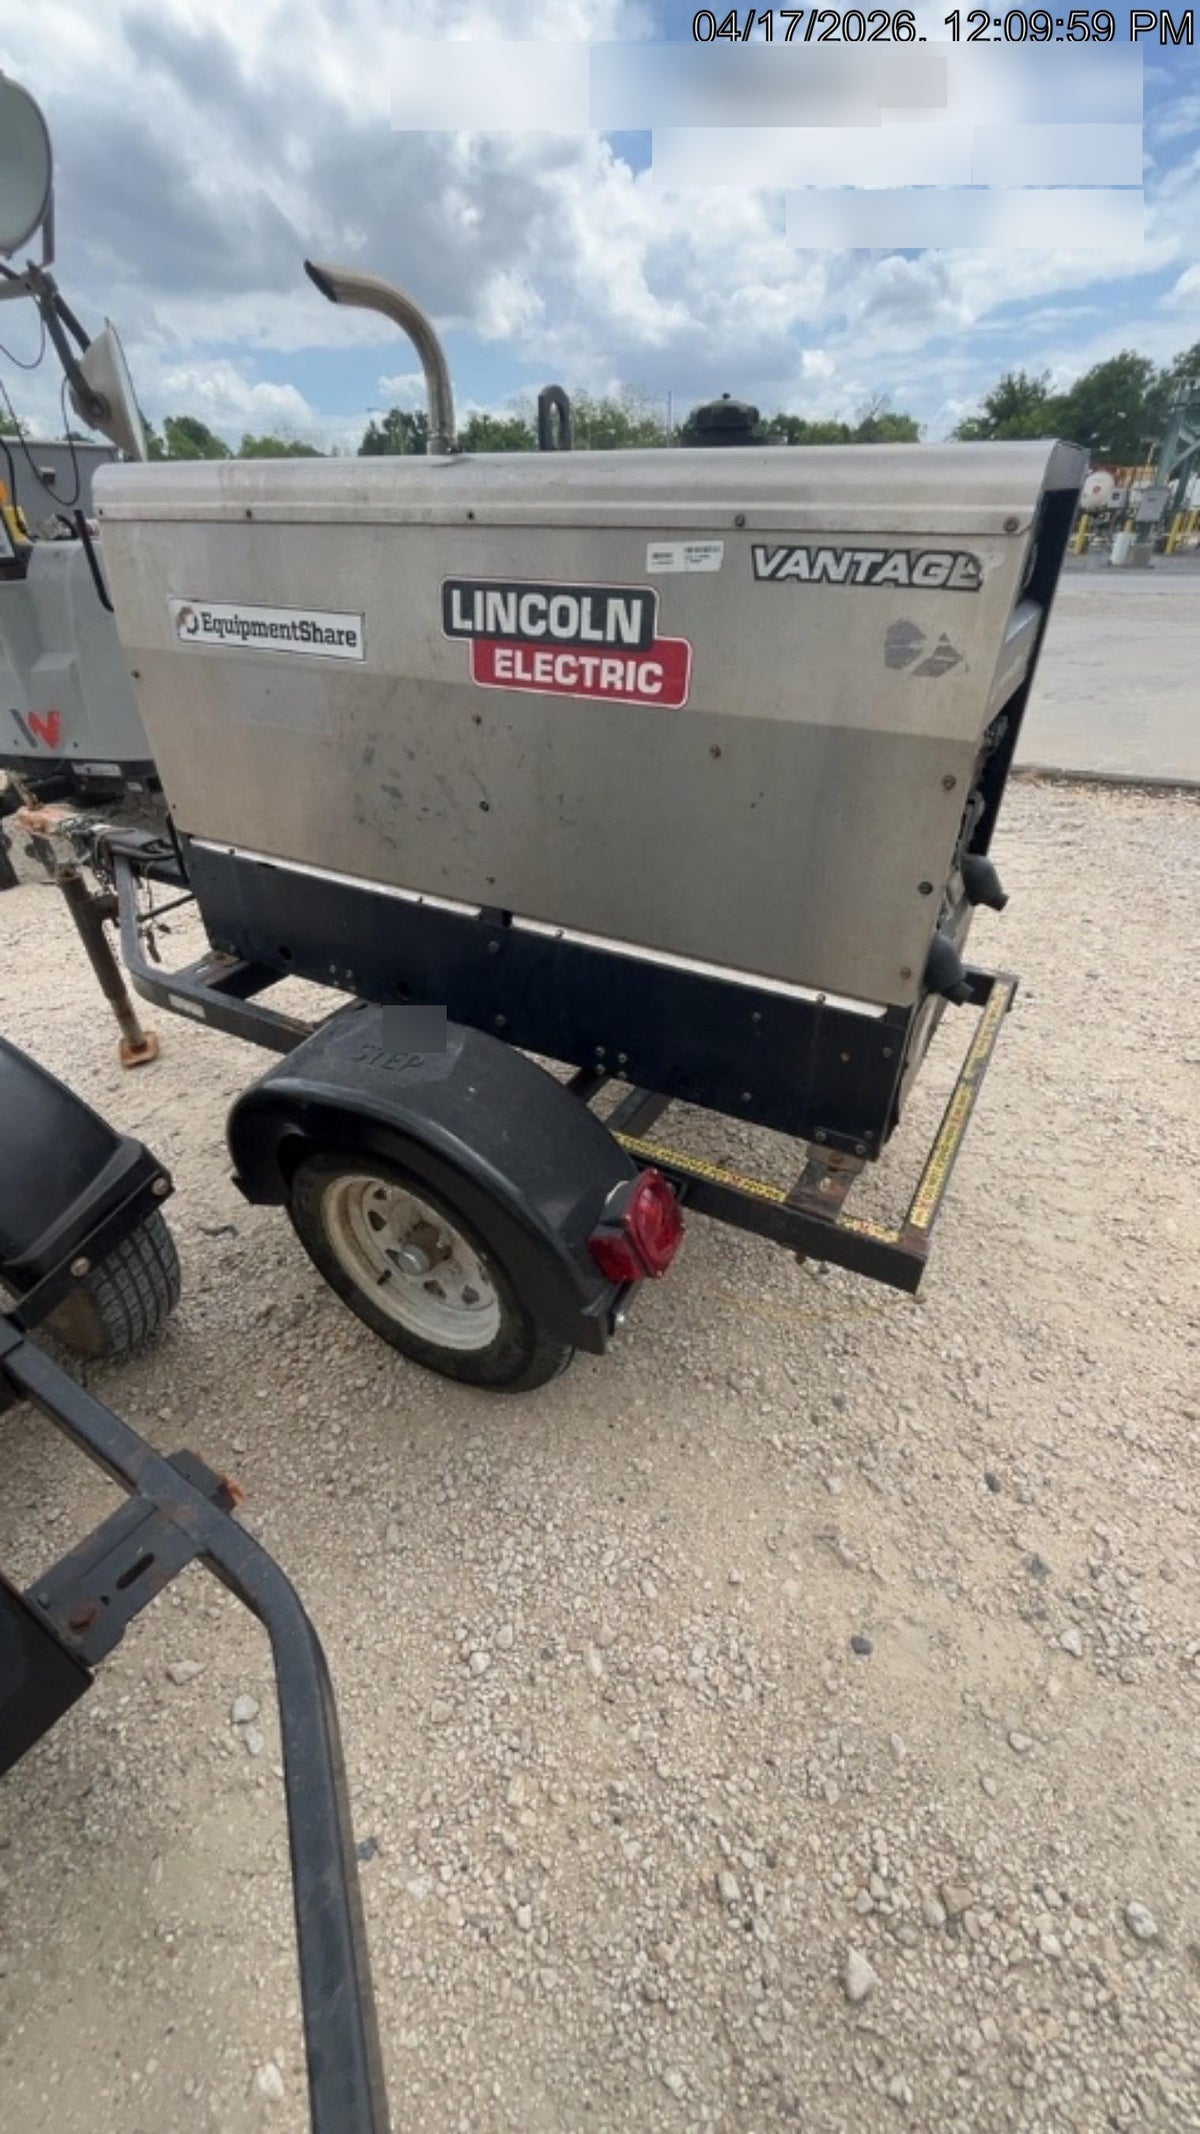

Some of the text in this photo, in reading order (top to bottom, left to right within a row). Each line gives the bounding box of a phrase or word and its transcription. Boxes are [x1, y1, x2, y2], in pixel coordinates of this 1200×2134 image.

[201, 612, 357, 647] EquipmentShare
[452, 589, 642, 643] LINCOLN
[494, 648, 663, 694] ELECTRIC
